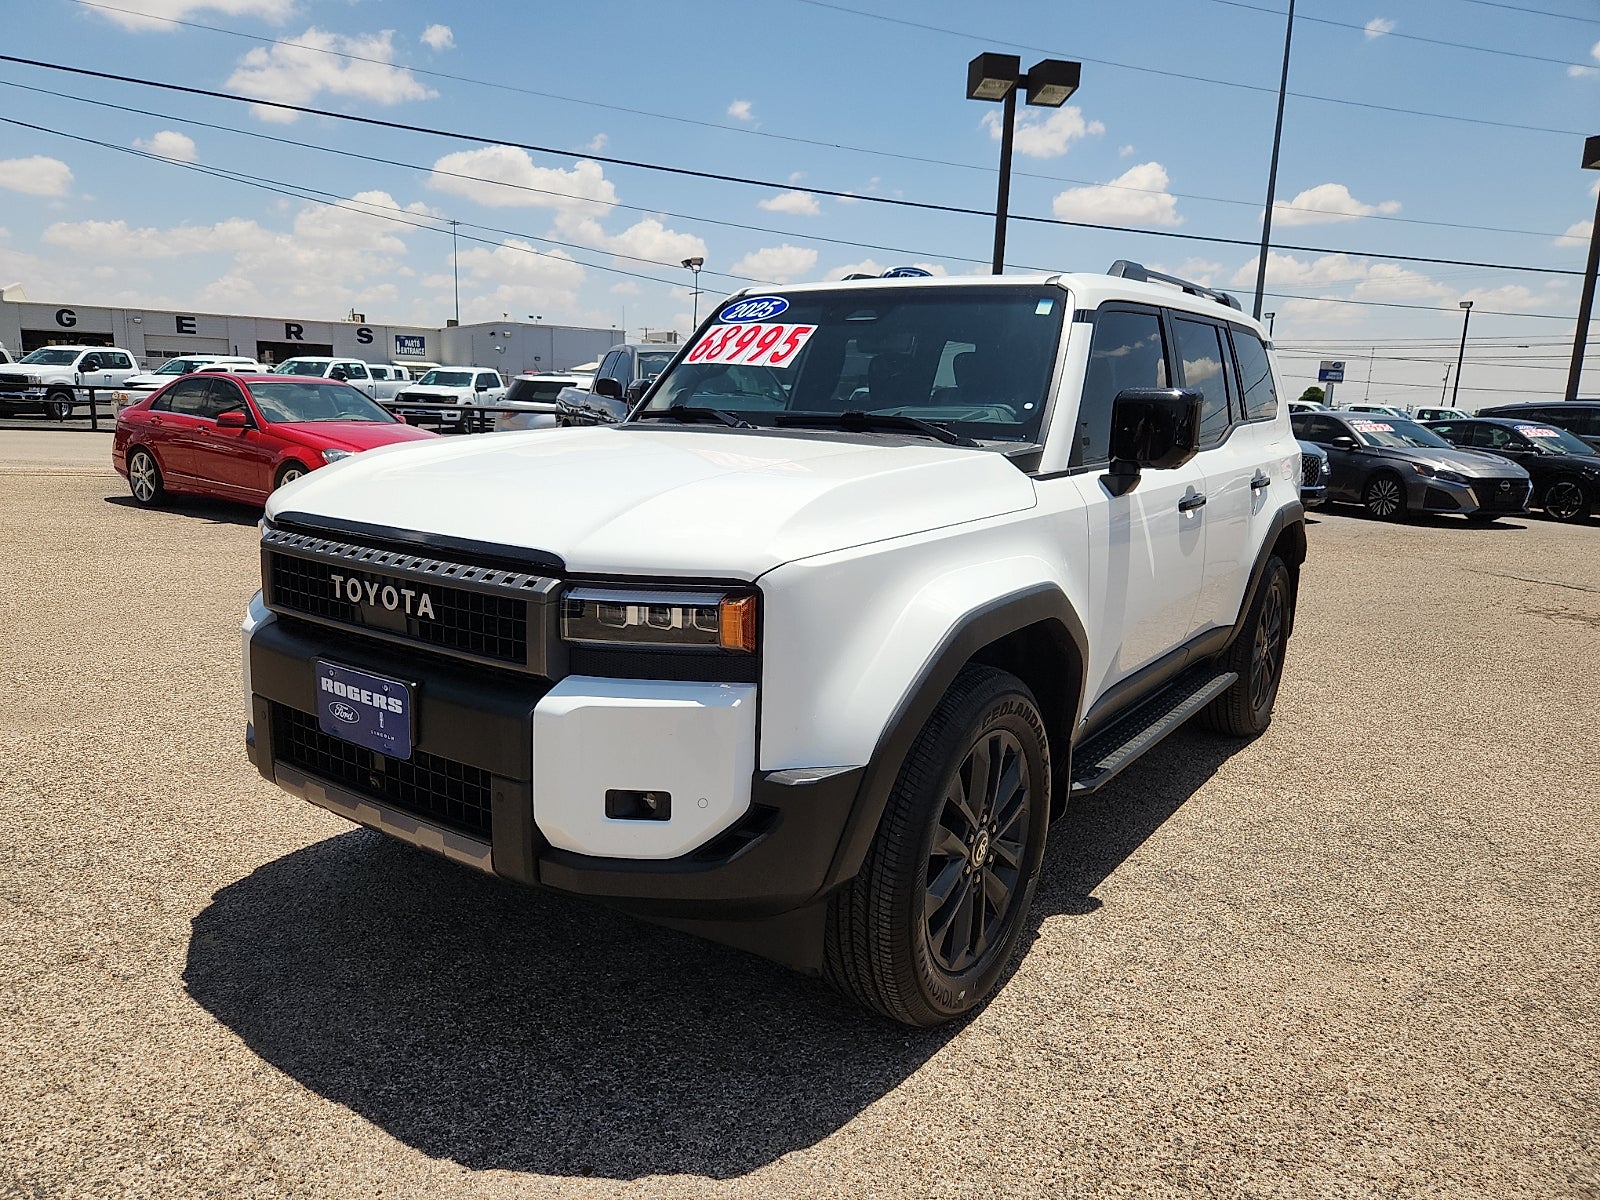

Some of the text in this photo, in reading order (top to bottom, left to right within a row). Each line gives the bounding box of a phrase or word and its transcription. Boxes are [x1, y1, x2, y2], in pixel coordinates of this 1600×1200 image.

[725, 301, 781, 319] 2025
[400, 347, 425, 355] ENTRANCE
[404, 340, 420, 348] PARTS
[689, 325, 812, 364] 68995
[331, 574, 435, 619] TOYOTA
[321, 676, 403, 714] ROGERS
[334, 703, 354, 721] Ford
[981, 700, 1047, 751] GEOLANDAR
[370, 729, 395, 741] LINCOLN
